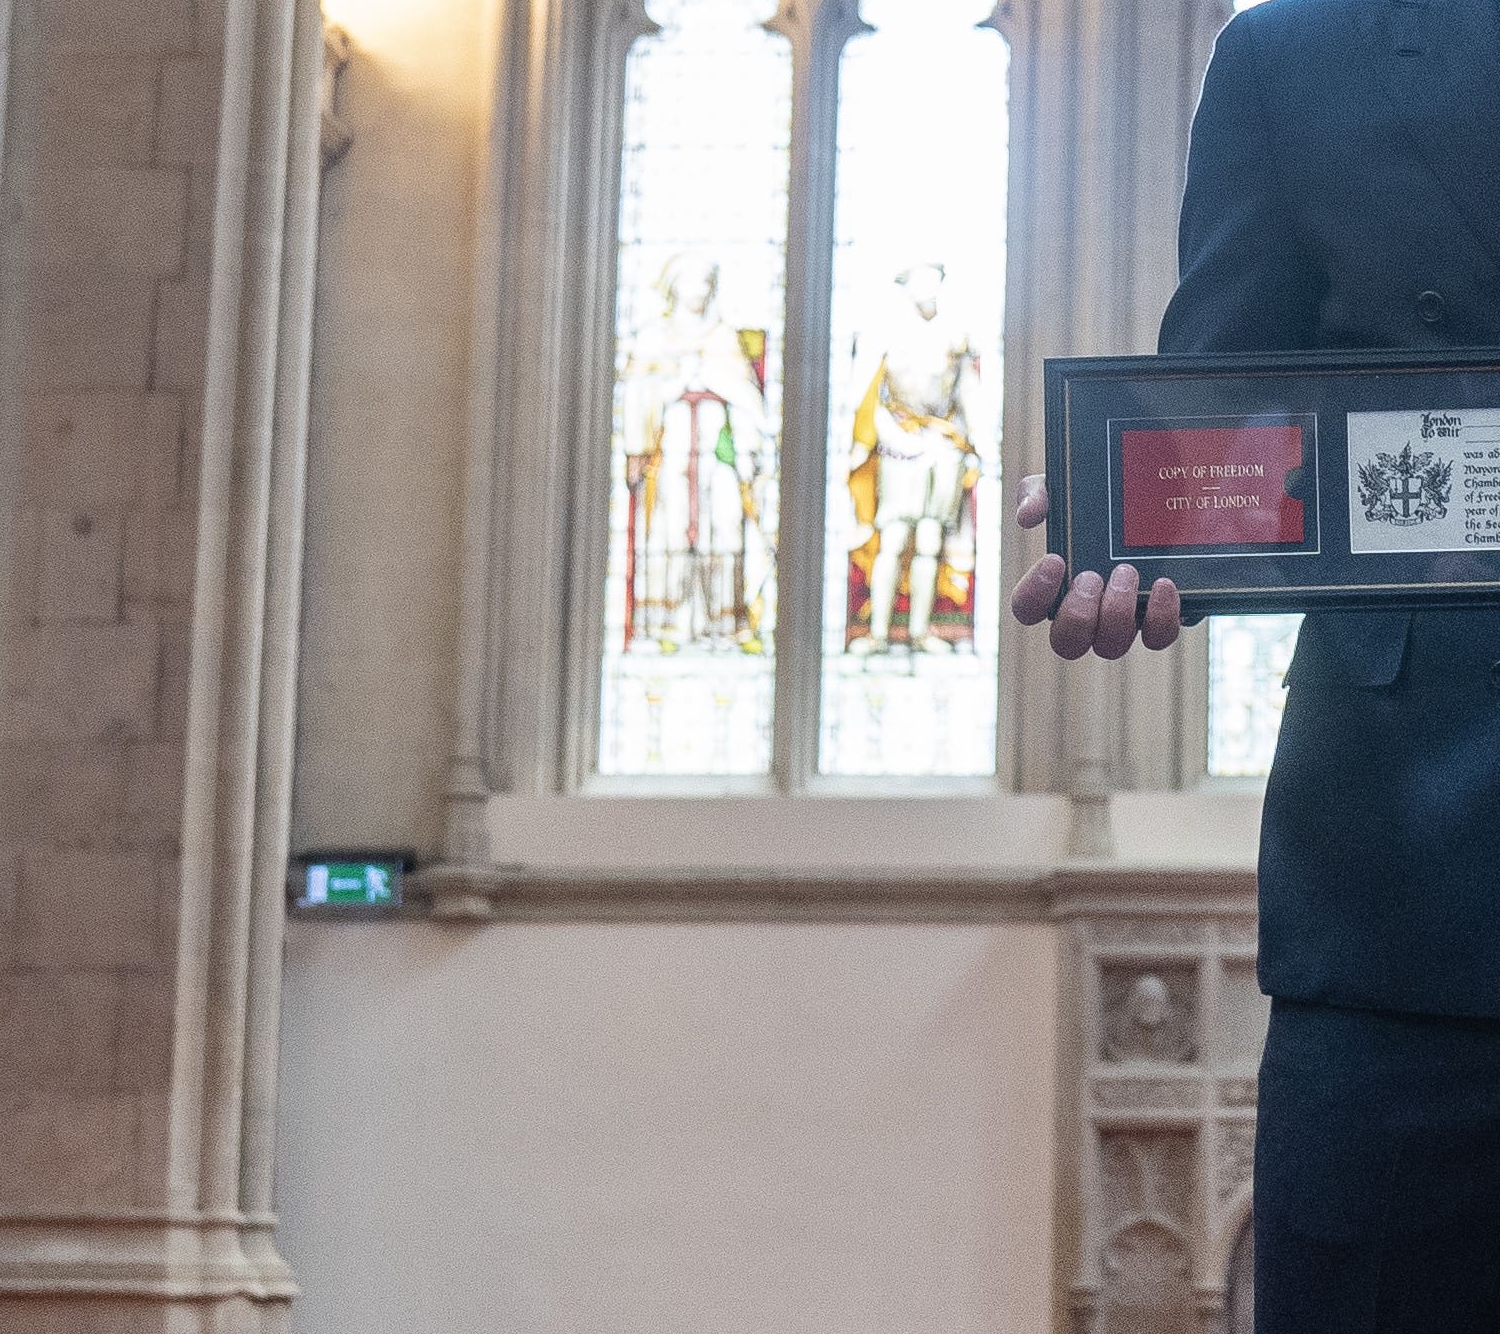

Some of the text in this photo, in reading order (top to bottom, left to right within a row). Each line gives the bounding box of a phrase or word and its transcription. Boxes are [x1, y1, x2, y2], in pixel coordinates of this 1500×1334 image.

[1421, 412, 1461, 427] London
[1421, 427, 1435, 438] To
[1463, 451, 1483, 459] was
[1159, 464, 1264, 479] COPY OF FREEDOM
[1166, 495, 1259, 510] CITY OF LONDON
[1464, 491, 1474, 502] of
[1464, 505, 1486, 518] year
[1489, 504, 1499, 516] of
[1465, 517, 1481, 529] the
